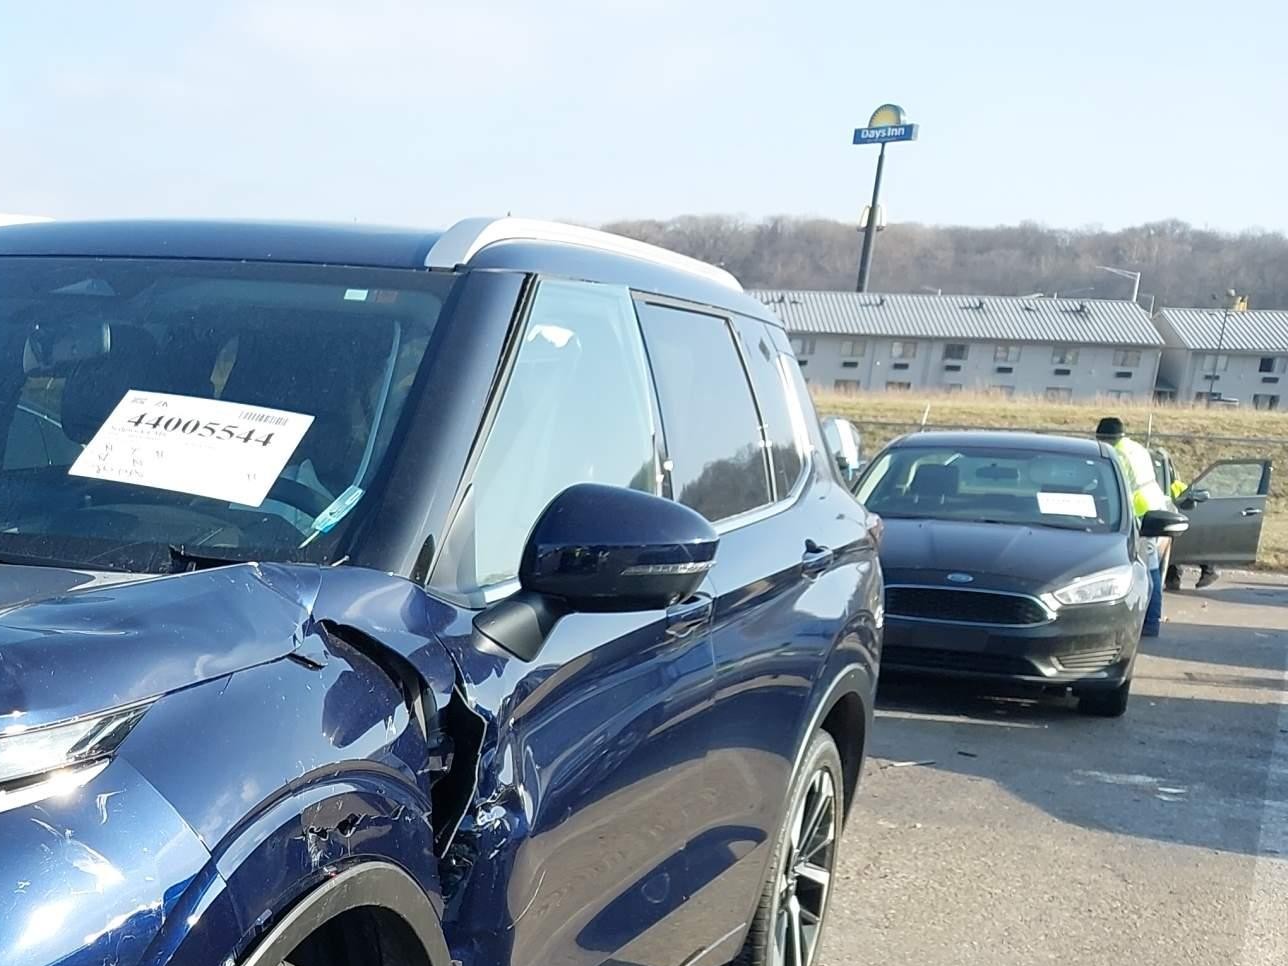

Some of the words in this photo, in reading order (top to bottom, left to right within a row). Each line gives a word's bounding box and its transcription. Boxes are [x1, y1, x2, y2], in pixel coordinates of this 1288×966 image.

[861, 129, 886, 139] Days
[887, 127, 905, 136] Inn
[127, 412, 275, 447] 44005544
